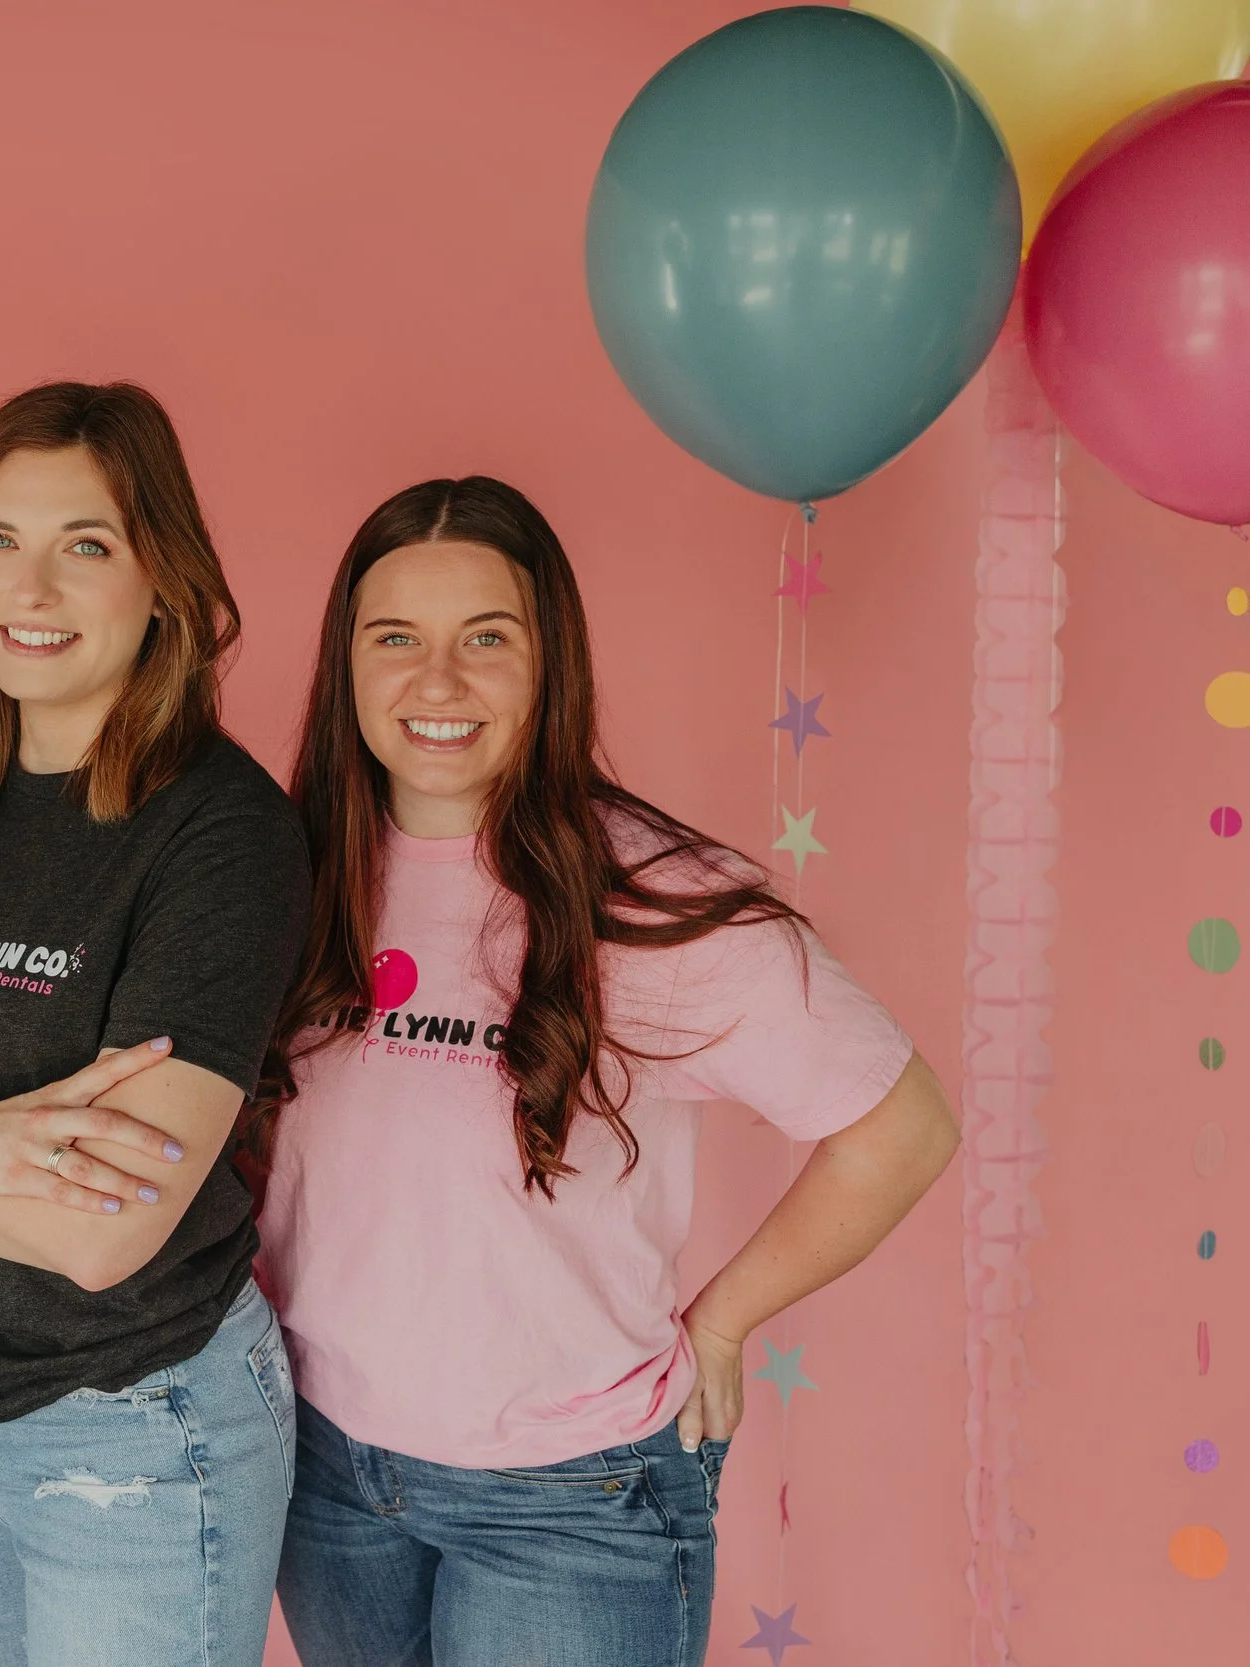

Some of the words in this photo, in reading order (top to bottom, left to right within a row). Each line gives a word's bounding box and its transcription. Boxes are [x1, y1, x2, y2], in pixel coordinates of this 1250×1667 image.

[25, 946, 70, 978] CO.
[383, 1012, 476, 1046] LYNN
[386, 1041, 440, 1060] Event
